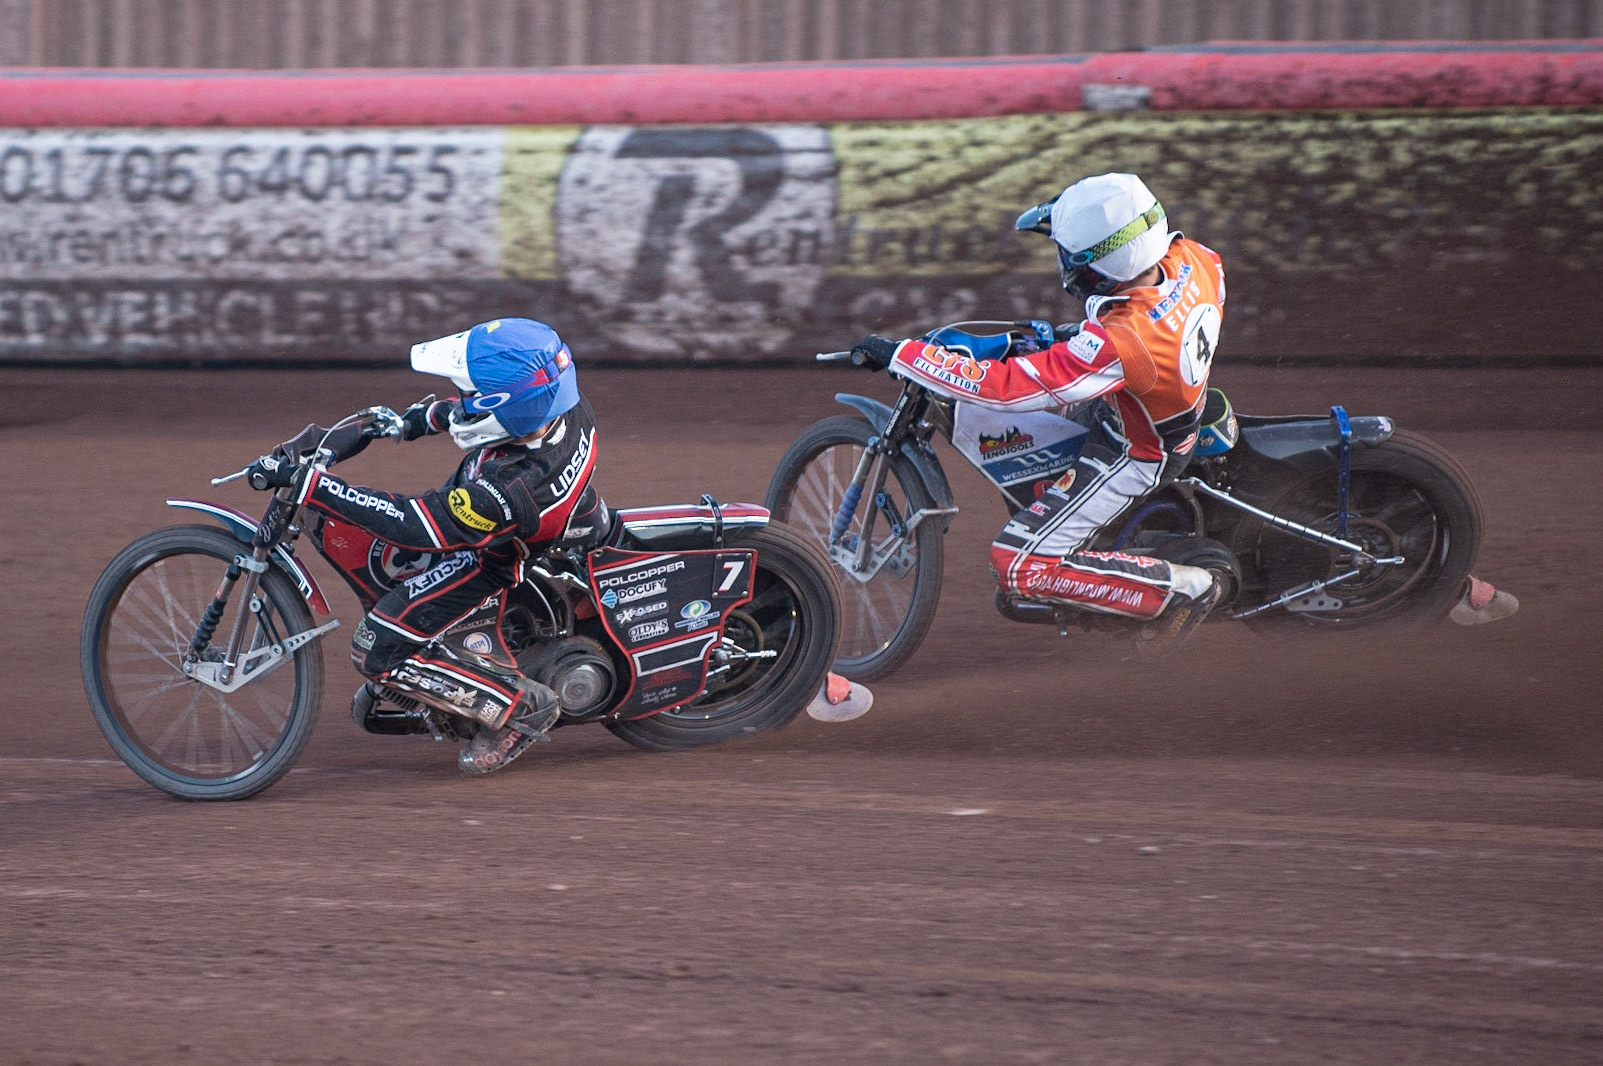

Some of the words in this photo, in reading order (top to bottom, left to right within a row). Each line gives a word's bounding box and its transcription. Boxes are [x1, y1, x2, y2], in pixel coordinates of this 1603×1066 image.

[218, 145, 457, 201] 640055
[1165, 281, 1201, 332] ELLIS
[1196, 325, 1212, 365] 4
[914, 358, 980, 393] FILTRATION
[550, 427, 591, 497] LIDSEY
[318, 476, 405, 522] POLCOPPER
[451, 491, 493, 530] Rentruck
[599, 561, 685, 588] POLCOPPER
[618, 578, 667, 599] DOCUFY
[717, 560, 745, 593] 7
[616, 601, 668, 625] EXPOSED
